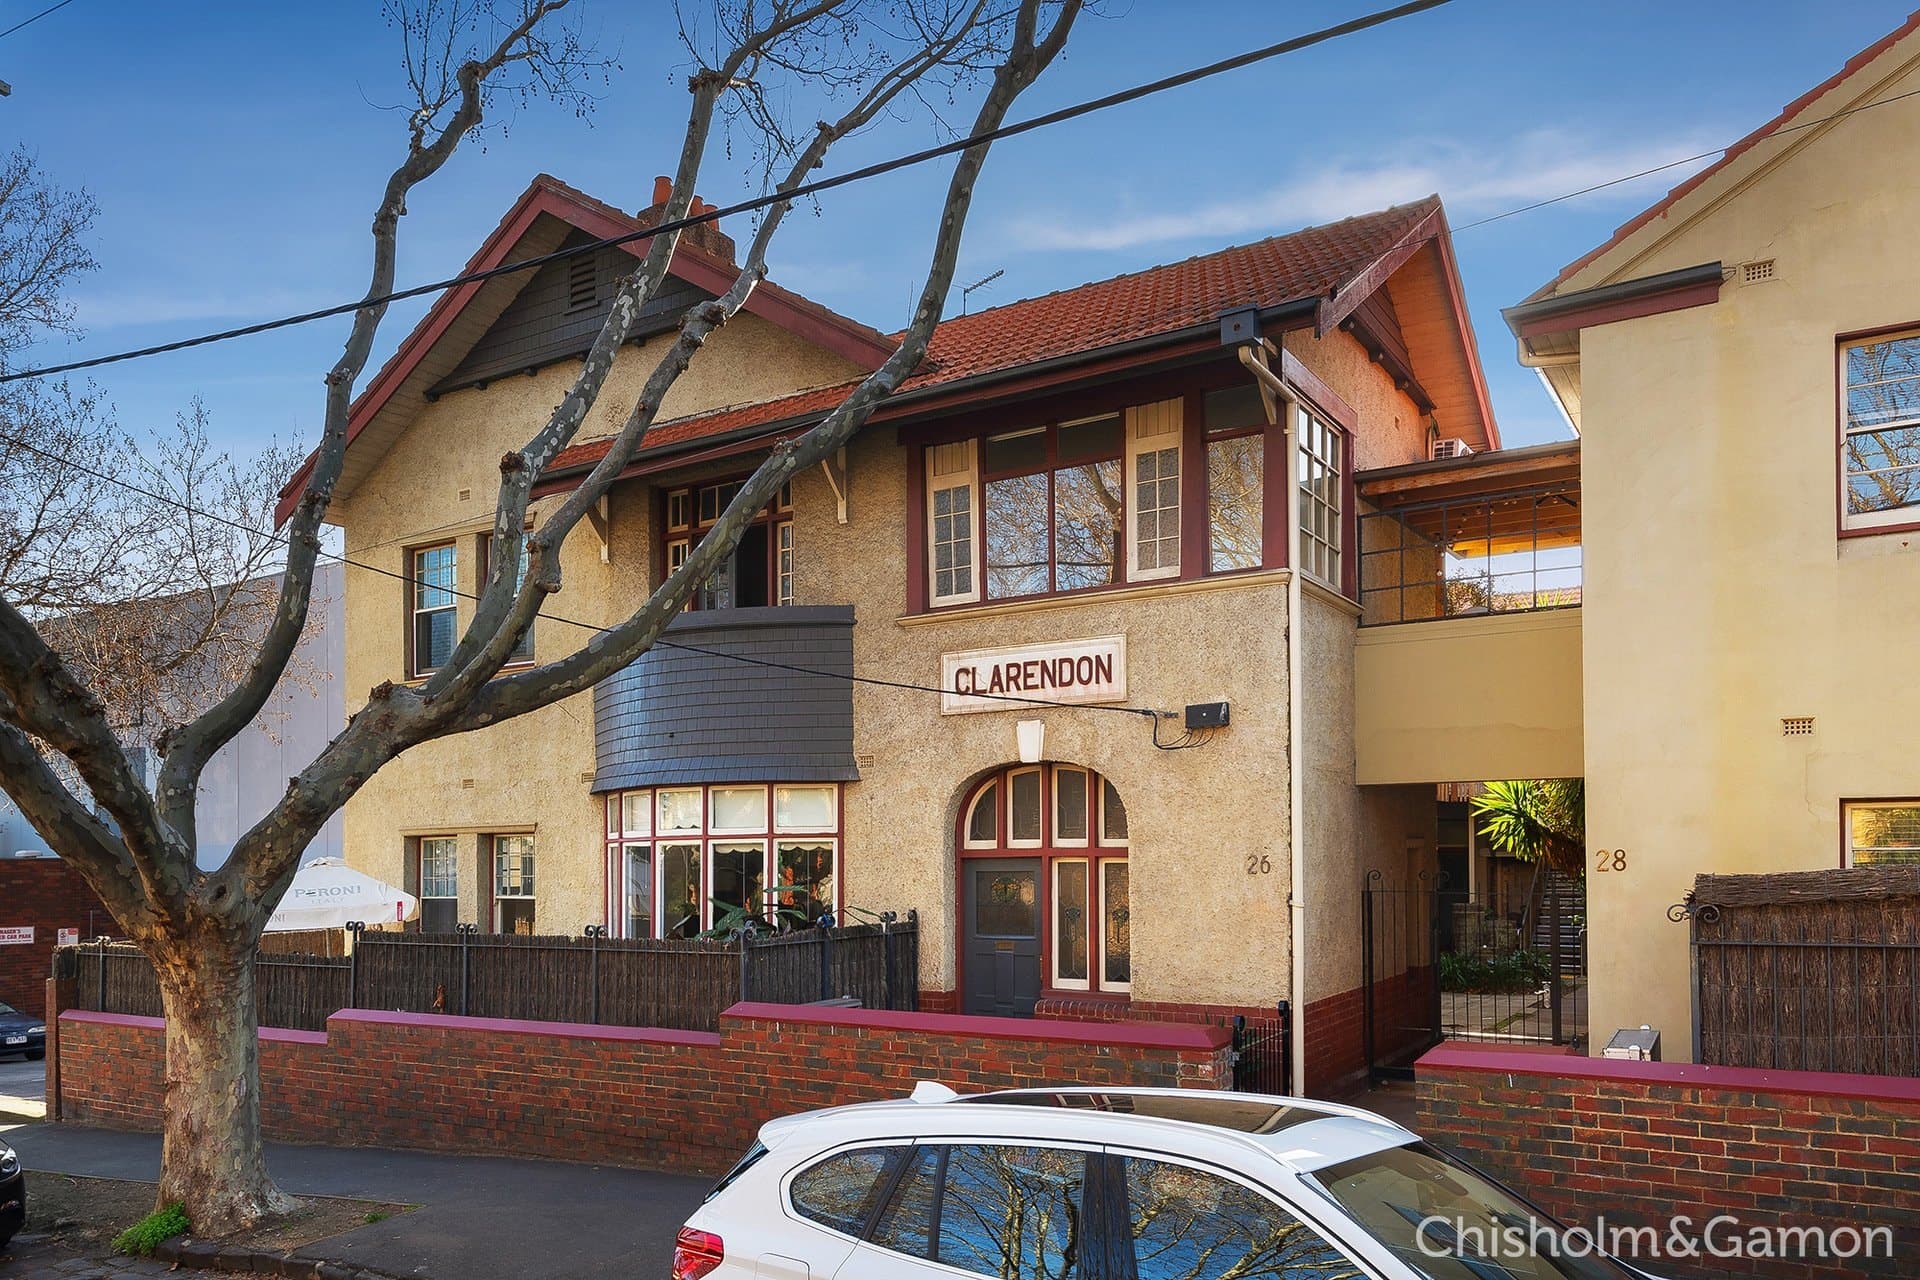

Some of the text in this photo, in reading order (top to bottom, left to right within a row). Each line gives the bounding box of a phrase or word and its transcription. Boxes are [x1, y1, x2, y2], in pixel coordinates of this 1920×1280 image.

[954, 653, 1113, 696] CLARENDON
[1247, 854, 1271, 875] 26
[1595, 848, 1627, 872] 28
[294, 885, 361, 898] PERONI
